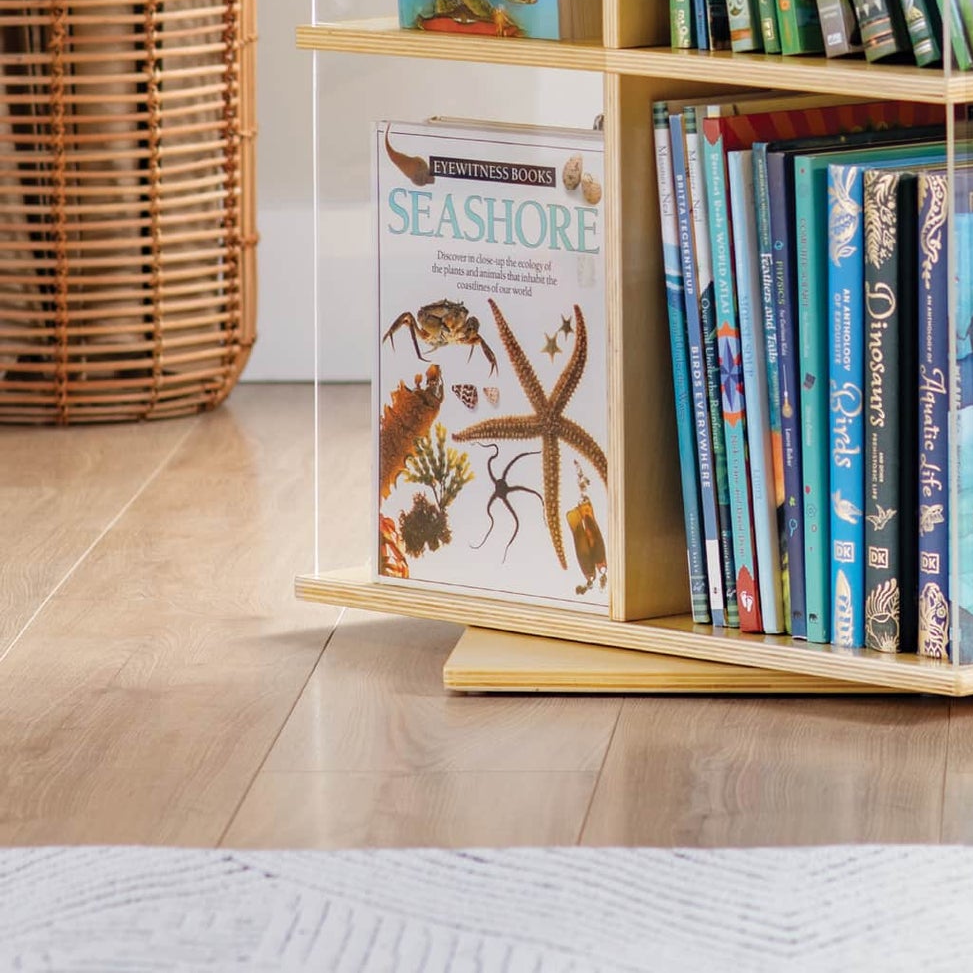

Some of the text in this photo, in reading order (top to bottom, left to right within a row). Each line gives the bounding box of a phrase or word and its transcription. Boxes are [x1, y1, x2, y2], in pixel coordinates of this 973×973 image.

[433, 160, 553, 184] EYEWITNESS BOOKS
[387, 187, 600, 255] SEASHORE
[661, 193, 673, 218] Neal
[431, 264, 557, 286] the plants and animals that inhabit the
[437, 250, 552, 272] Discover in close-up the ecology of
[716, 231, 731, 314] WORLD ATLAS
[456, 280, 532, 297] coastlines of our world
[760, 253, 773, 309] Feathers
[776, 260, 786, 305] PHYSICS
[926, 294, 932, 306] AN
[675, 174, 712, 489] BRITTA TECKENTRUP BIRDS EVERYWHERE
[765, 312, 775, 329] and
[842, 288, 852, 371] AN ANTHOLOGY
[766, 333, 778, 364] Tails
[865, 281, 896, 428] Dinosaurs
[927, 353, 934, 364] OF
[700, 297, 721, 449] Over and Under the Rainforest
[829, 292, 863, 468] OF EXQUISITE Birds
[919, 364, 947, 451] Aquatic
[919, 453, 943, 497] Life
[836, 544, 851, 558] DK
[870, 550, 886, 565] DK
[922, 556, 938, 571] DK
